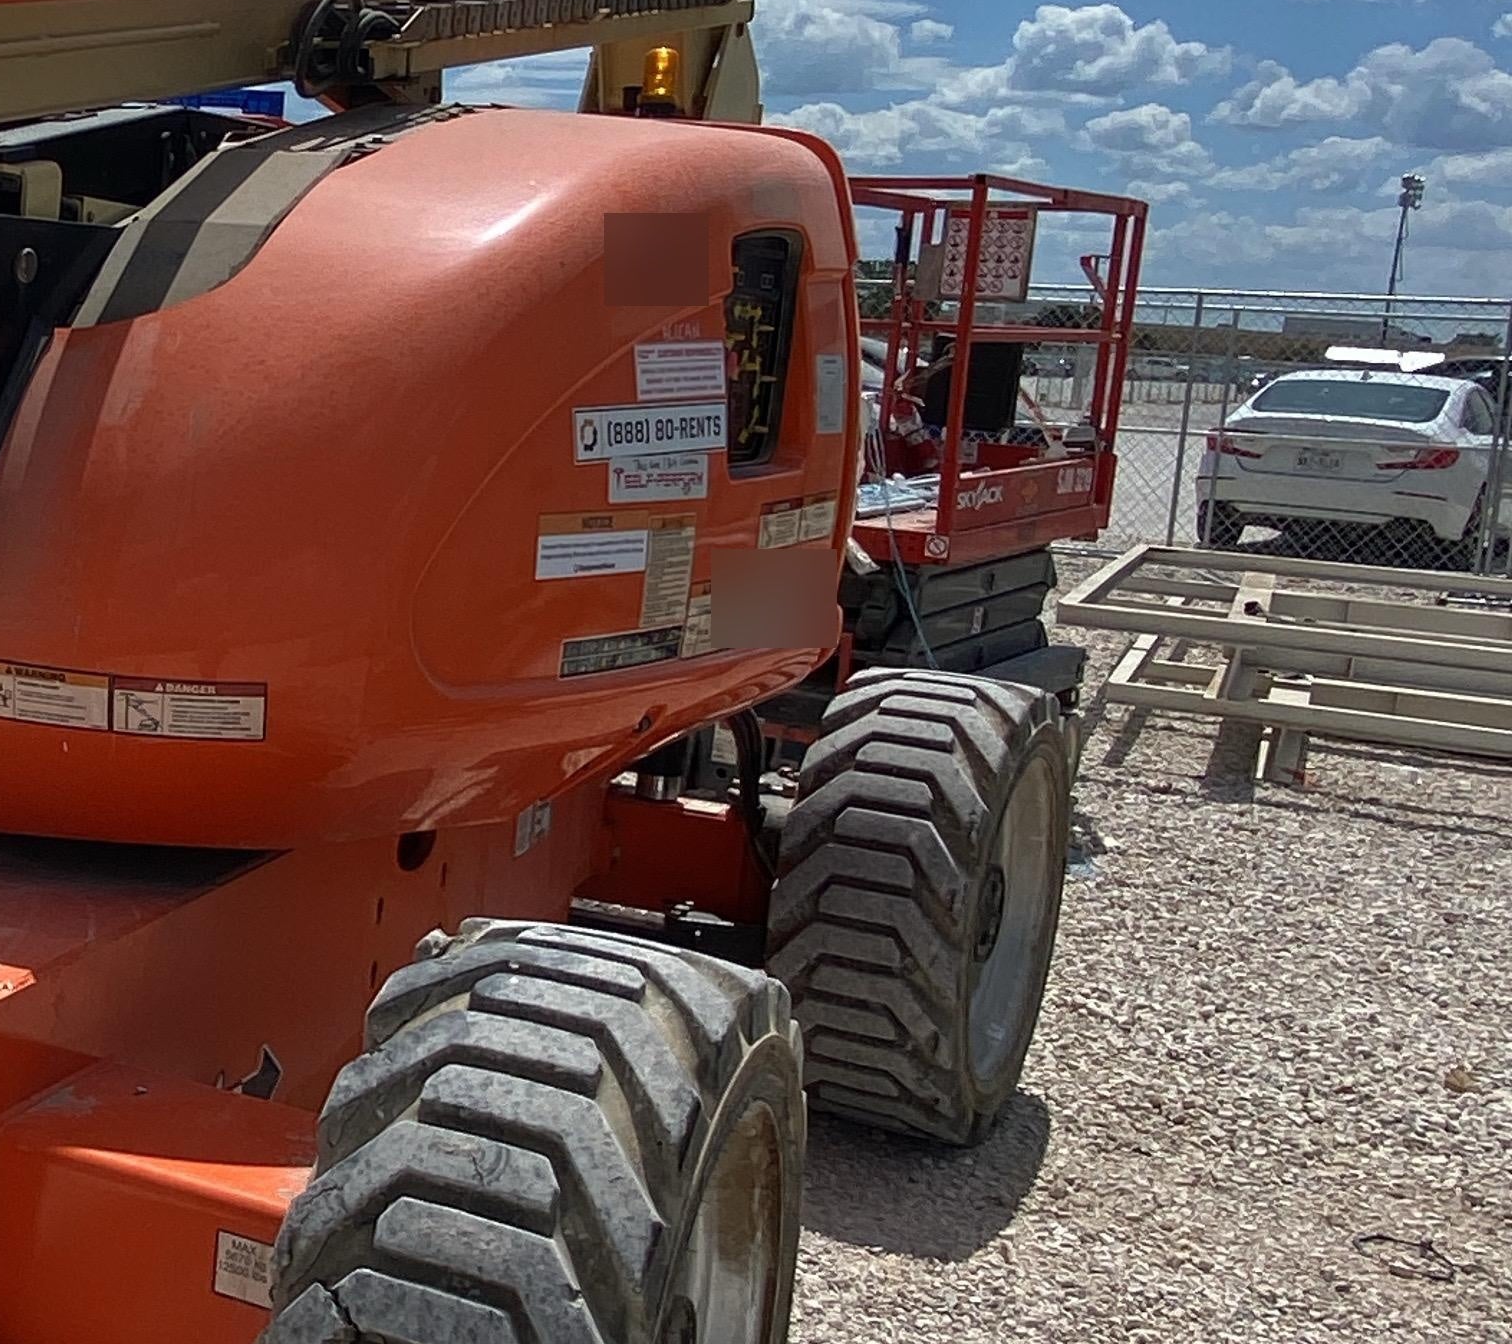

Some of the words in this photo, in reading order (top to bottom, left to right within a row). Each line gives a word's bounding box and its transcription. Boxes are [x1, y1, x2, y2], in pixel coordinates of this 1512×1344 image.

[607, 418, 650, 447] (888)
[655, 415, 721, 441] 80-RENTS
[166, 682, 217, 695] DANGER
